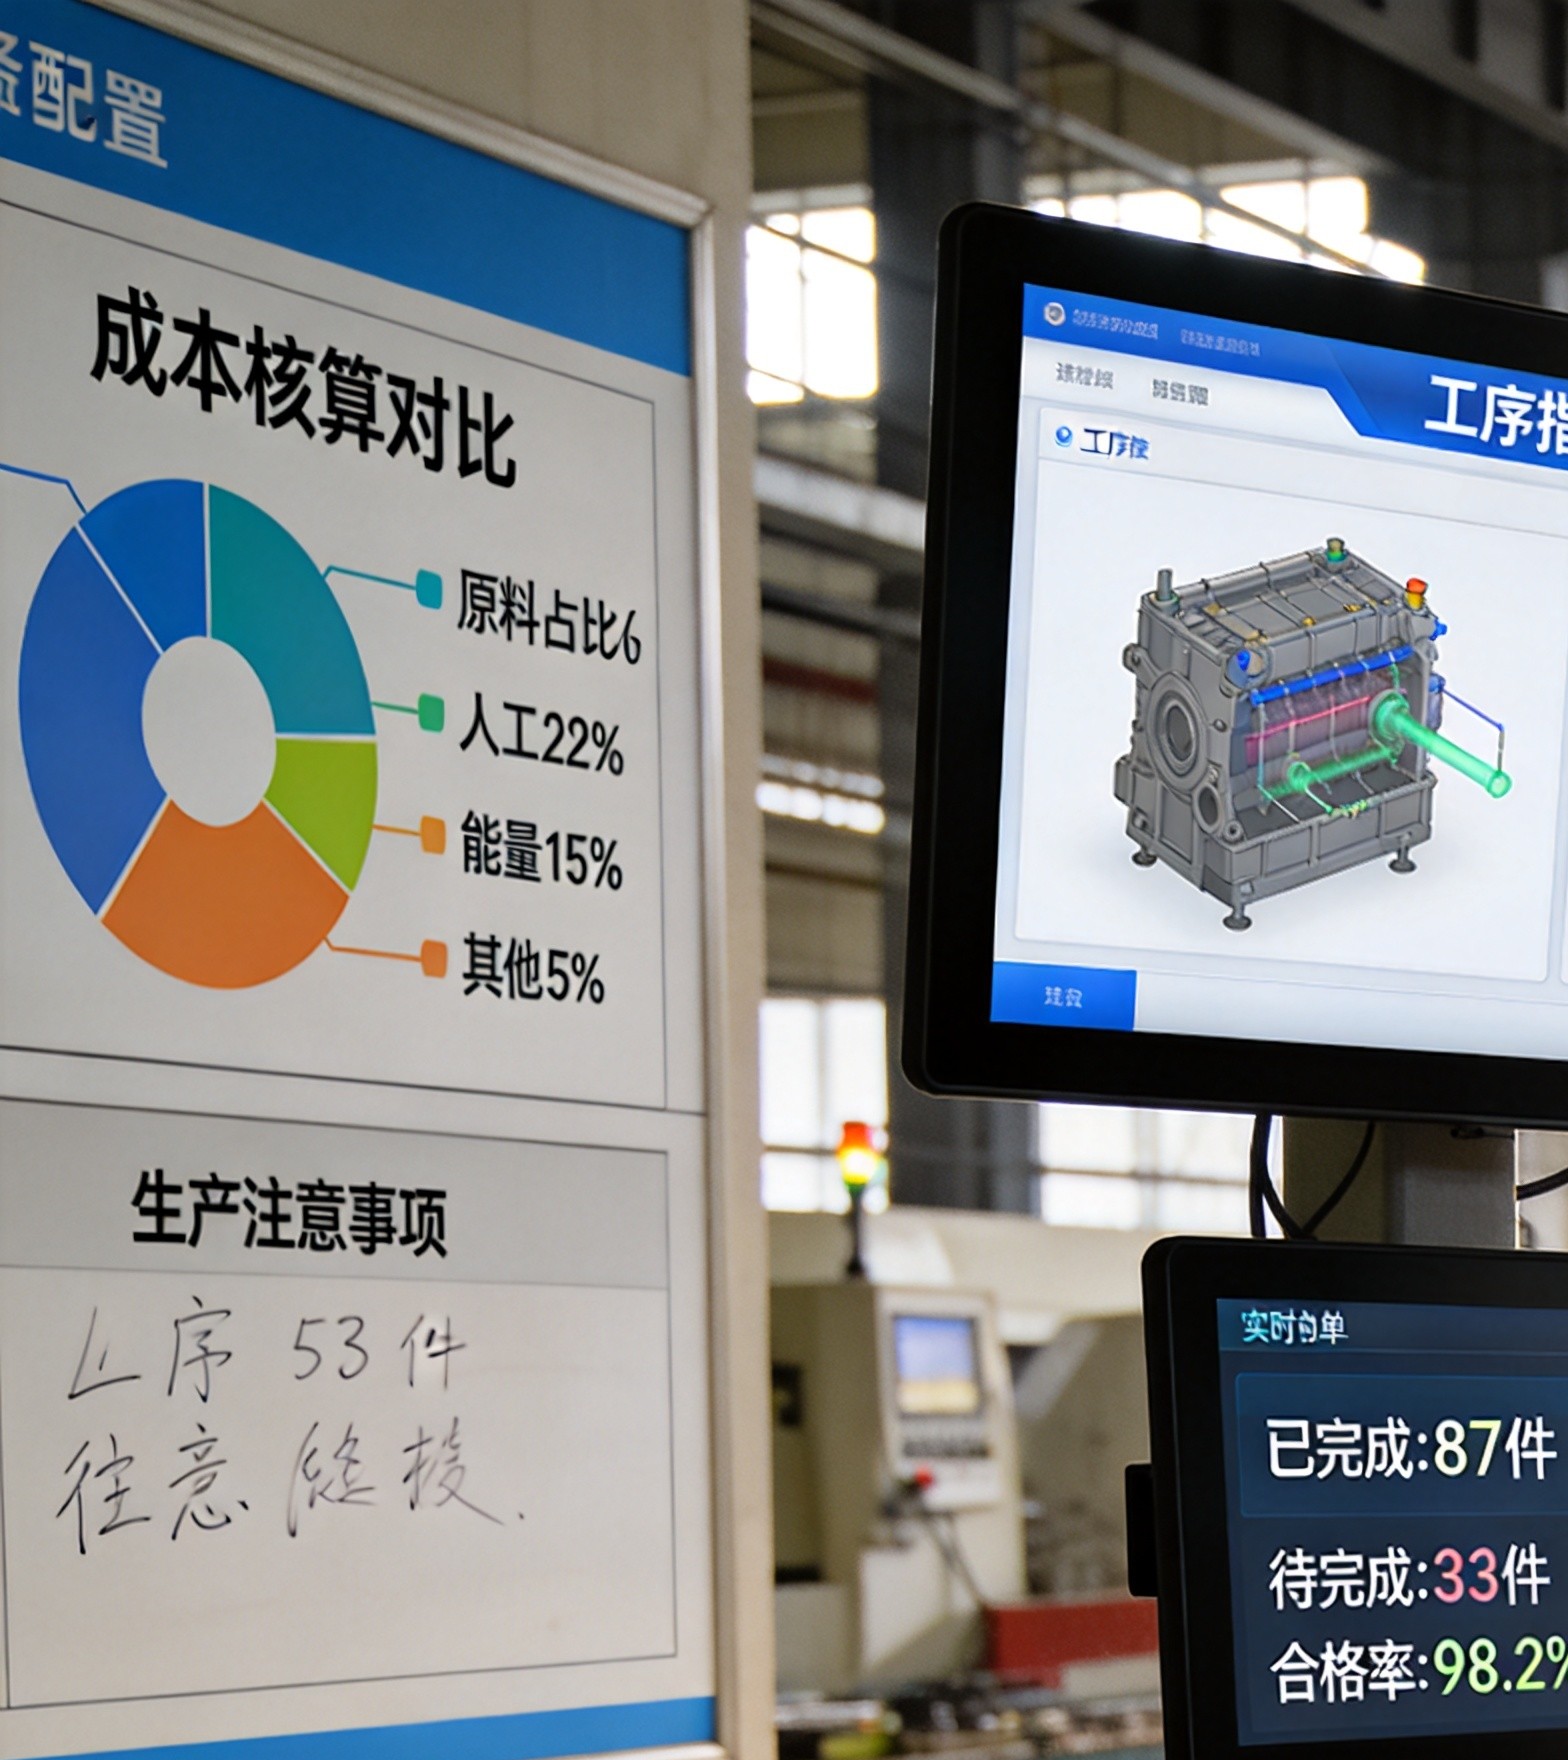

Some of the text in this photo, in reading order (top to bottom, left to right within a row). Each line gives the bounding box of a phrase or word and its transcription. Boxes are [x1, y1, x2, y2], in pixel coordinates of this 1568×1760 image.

[90, 285, 517, 489] 成本核算对比
[457, 568, 642, 665] 原料占比6
[459, 691, 624, 776] 人工22%
[460, 809, 623, 891] 能量15%
[462, 931, 605, 1005] 其他5%
[130, 1168, 448, 1259] 生产注意事项
[1266, 1416, 1558, 1480] 已完成:87件
[1269, 1542, 1551, 1610] 待完成:33件
